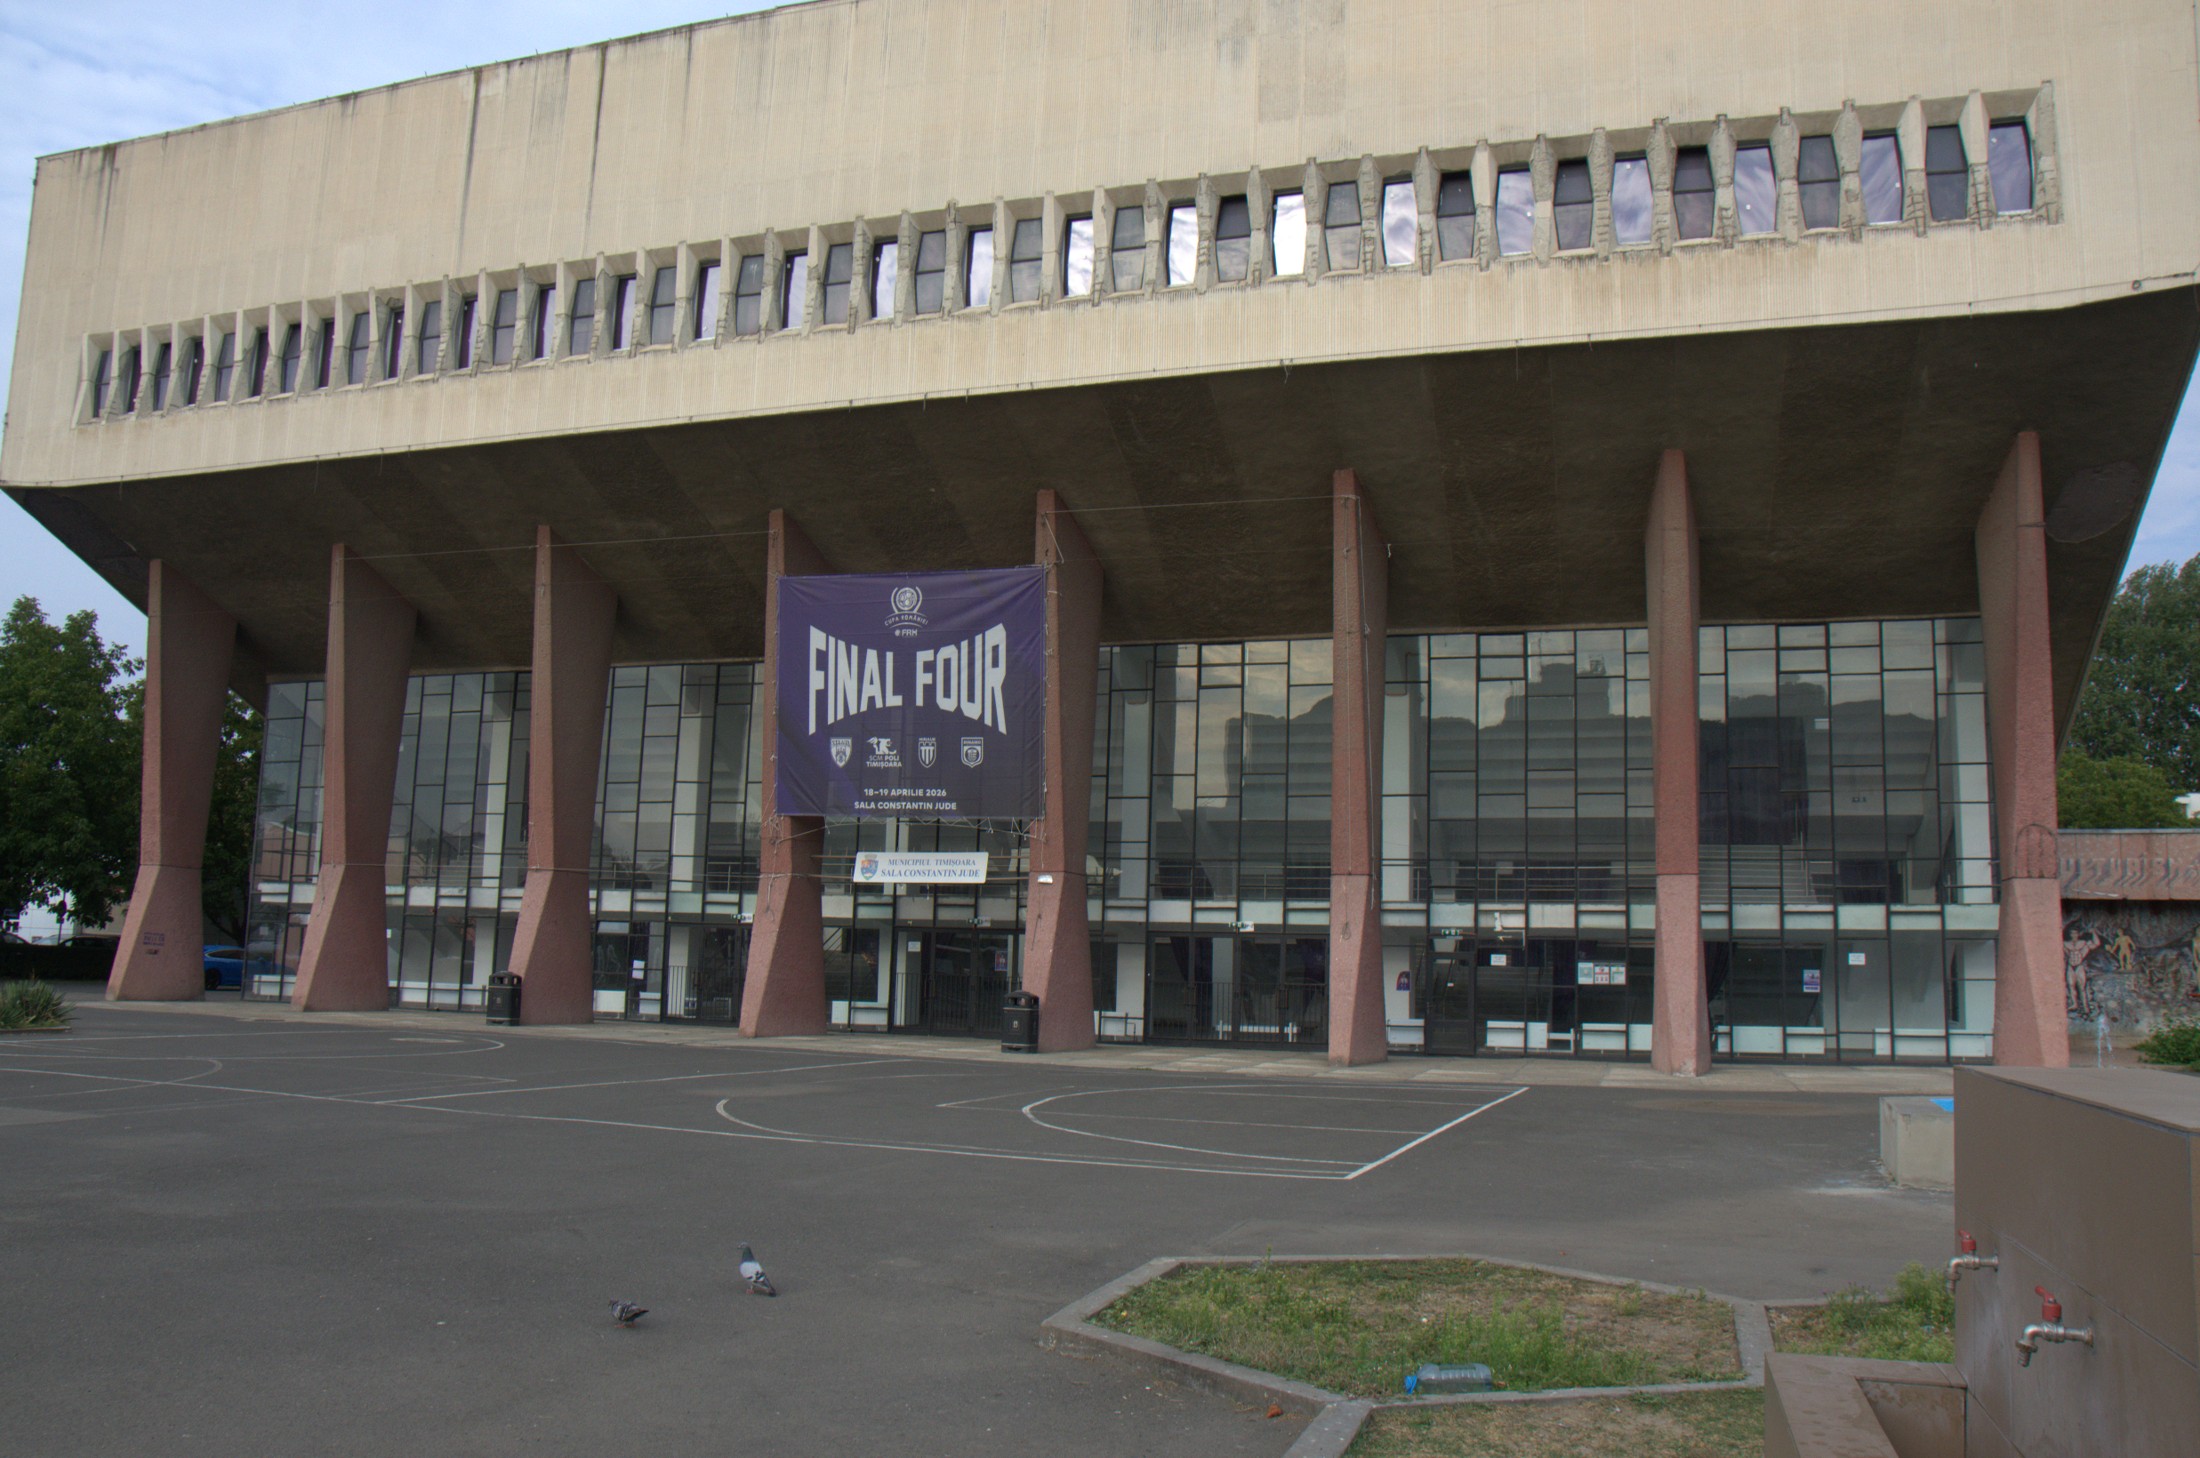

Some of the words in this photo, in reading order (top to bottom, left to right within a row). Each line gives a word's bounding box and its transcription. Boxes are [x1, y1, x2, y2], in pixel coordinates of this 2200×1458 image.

[808, 625, 903, 736] FINAL
[915, 622, 1007, 736] FOUR
[866, 761, 902, 769] TIMIȘOARA
[890, 788, 924, 797] APRILIE
[926, 788, 947, 797] 2026
[854, 801, 875, 810] SALA
[877, 802, 933, 810] CONSTANTIN
[935, 802, 957, 810] JUDE
[888, 859, 931, 867] MUNICIPIUL
[935, 859, 976, 868] TIMIȘOARA
[881, 869, 903, 877] SALA
[904, 869, 958, 878] CONSTANTIN
[959, 869, 980, 878] JUDE
